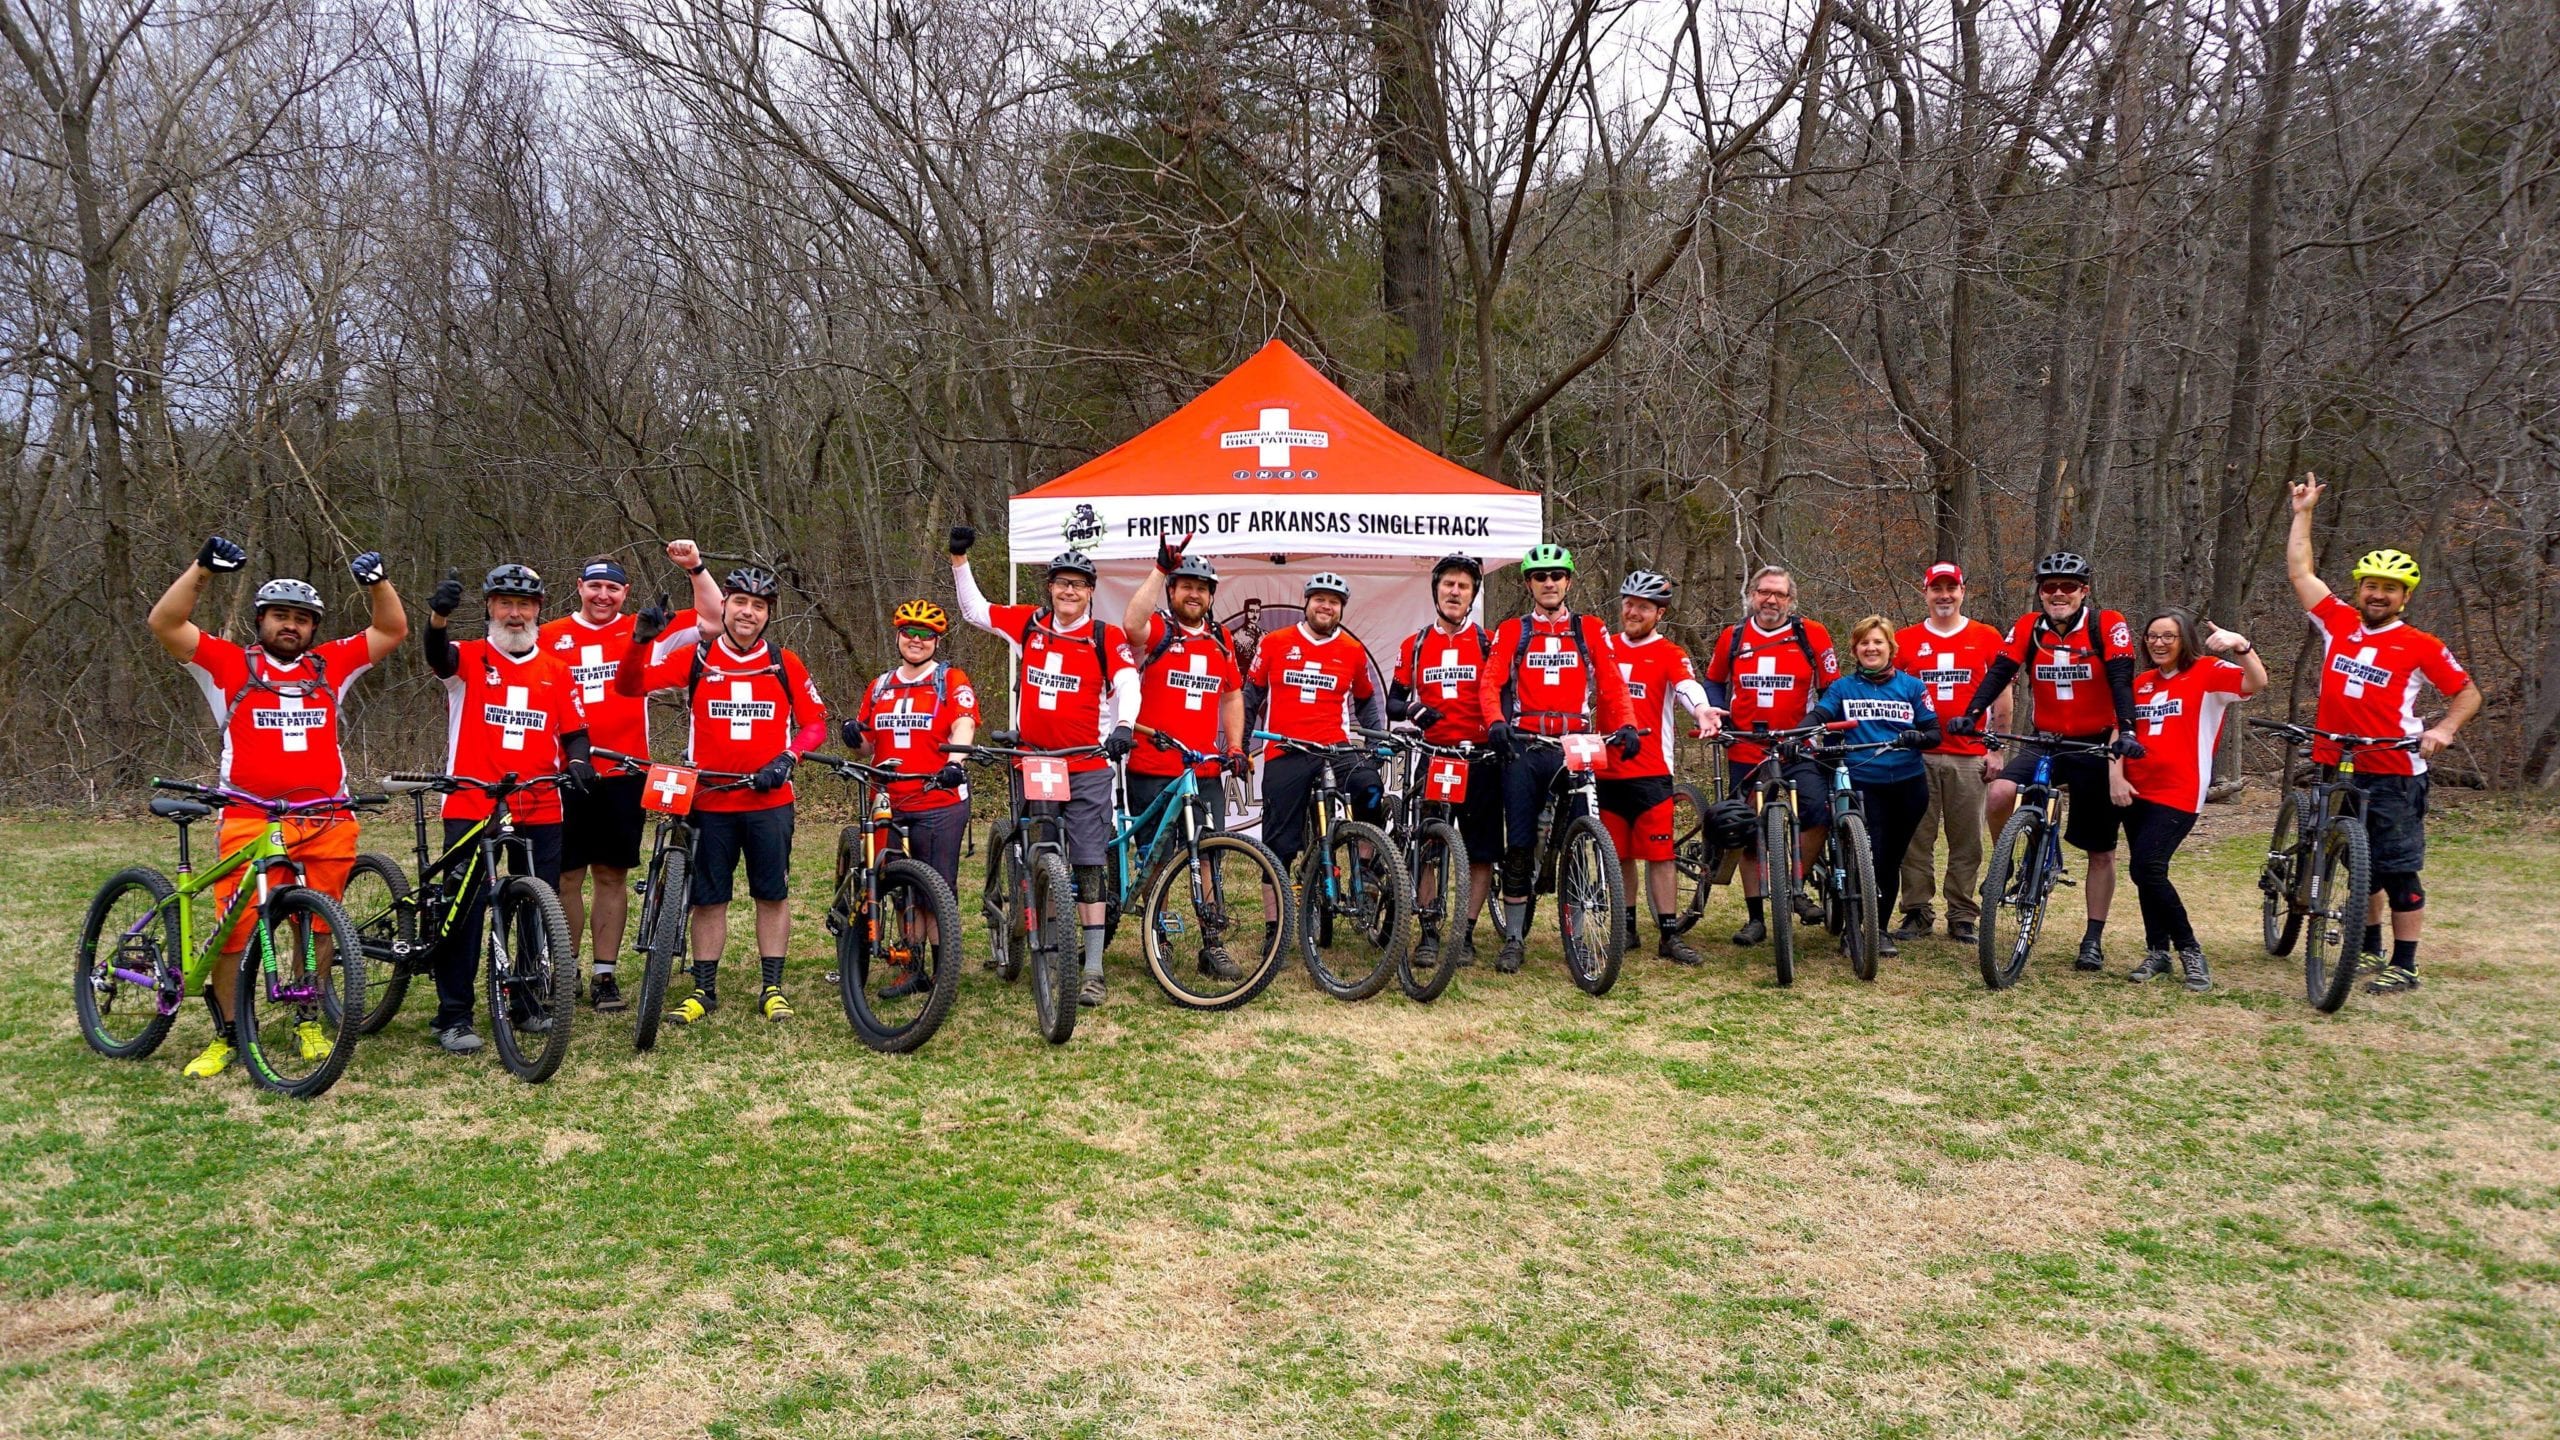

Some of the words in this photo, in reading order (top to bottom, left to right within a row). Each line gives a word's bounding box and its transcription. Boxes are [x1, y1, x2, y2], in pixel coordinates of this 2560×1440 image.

[1225, 430, 1271, 439] NATIONAL
[1275, 430, 1325, 439] MOUNTAIN
[1226, 438, 1256, 446] BIKE
[1260, 437, 1311, 445] PATROL
[1127, 514, 1209, 537] FRIENDS
[1217, 512, 1241, 533] OF
[1248, 510, 1351, 533] ARKANSAS
[1358, 513, 1489, 537] SINGLETRACK
[1549, 658, 1575, 666] PATROL
[1425, 673, 1443, 682] BIKE
[1444, 672, 1474, 680] PATROL
[1922, 675, 1939, 683] BIKE
[1941, 674, 1970, 682] PATROL
[2037, 671, 2056, 679] BIKE
[2057, 670, 2090, 679] PATROL
[1029, 674, 1042, 685] BIKE
[1045, 678, 1076, 690] PATROL
[1170, 677, 1190, 687] BIKE
[1191, 680, 1217, 691] PATROL
[1285, 675, 1303, 684] BIKE
[1305, 678, 1333, 689] PATROL
[515, 710, 544, 719] MOUNTAIN
[711, 708, 734, 716] BIKE
[736, 709, 771, 717] PATROL
[1849, 708, 1869, 718] BIKE
[1870, 709, 1903, 719] PATROL
[257, 718, 285, 727] BIKE
[287, 717, 324, 727] PATROL
[485, 713, 508, 724] BIKE
[510, 716, 543, 728] PATROL
[896, 719, 928, 728] PATROL
